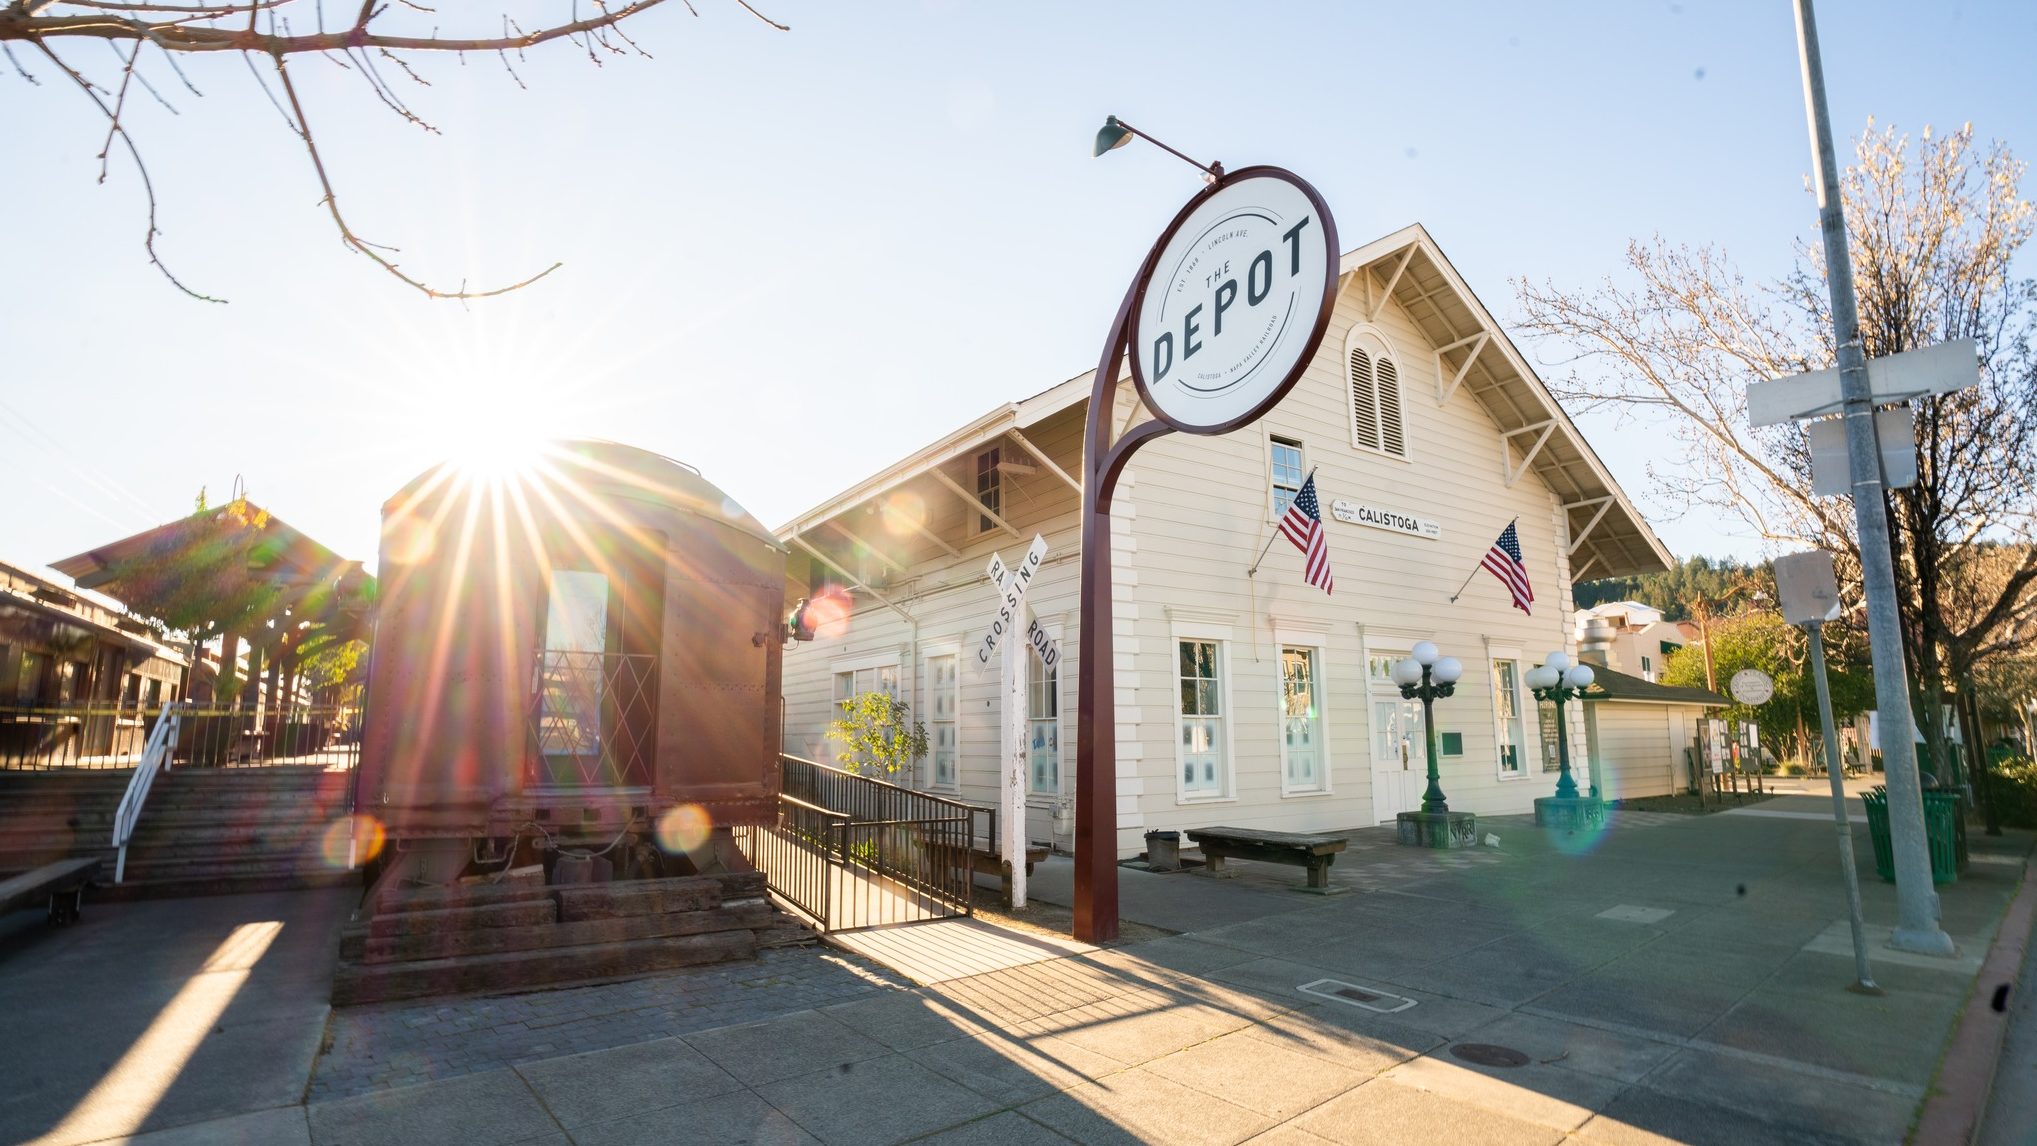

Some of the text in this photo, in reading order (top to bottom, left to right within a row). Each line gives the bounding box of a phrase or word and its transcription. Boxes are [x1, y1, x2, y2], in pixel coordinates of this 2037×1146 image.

[1208, 232, 1233, 250] LINCOLN
[1206, 260, 1230, 288] THE
[1153, 215, 1309, 385] DEPOT
[1230, 362, 1242, 372] NAPA
[1244, 345, 1259, 363] VALLEY
[1260, 315, 1277, 345] RAILROAD
[1358, 508, 1419, 532] CALISTOGA
[979, 552, 1039, 663] CROSSING
[1028, 619, 1056, 665] ROAD
